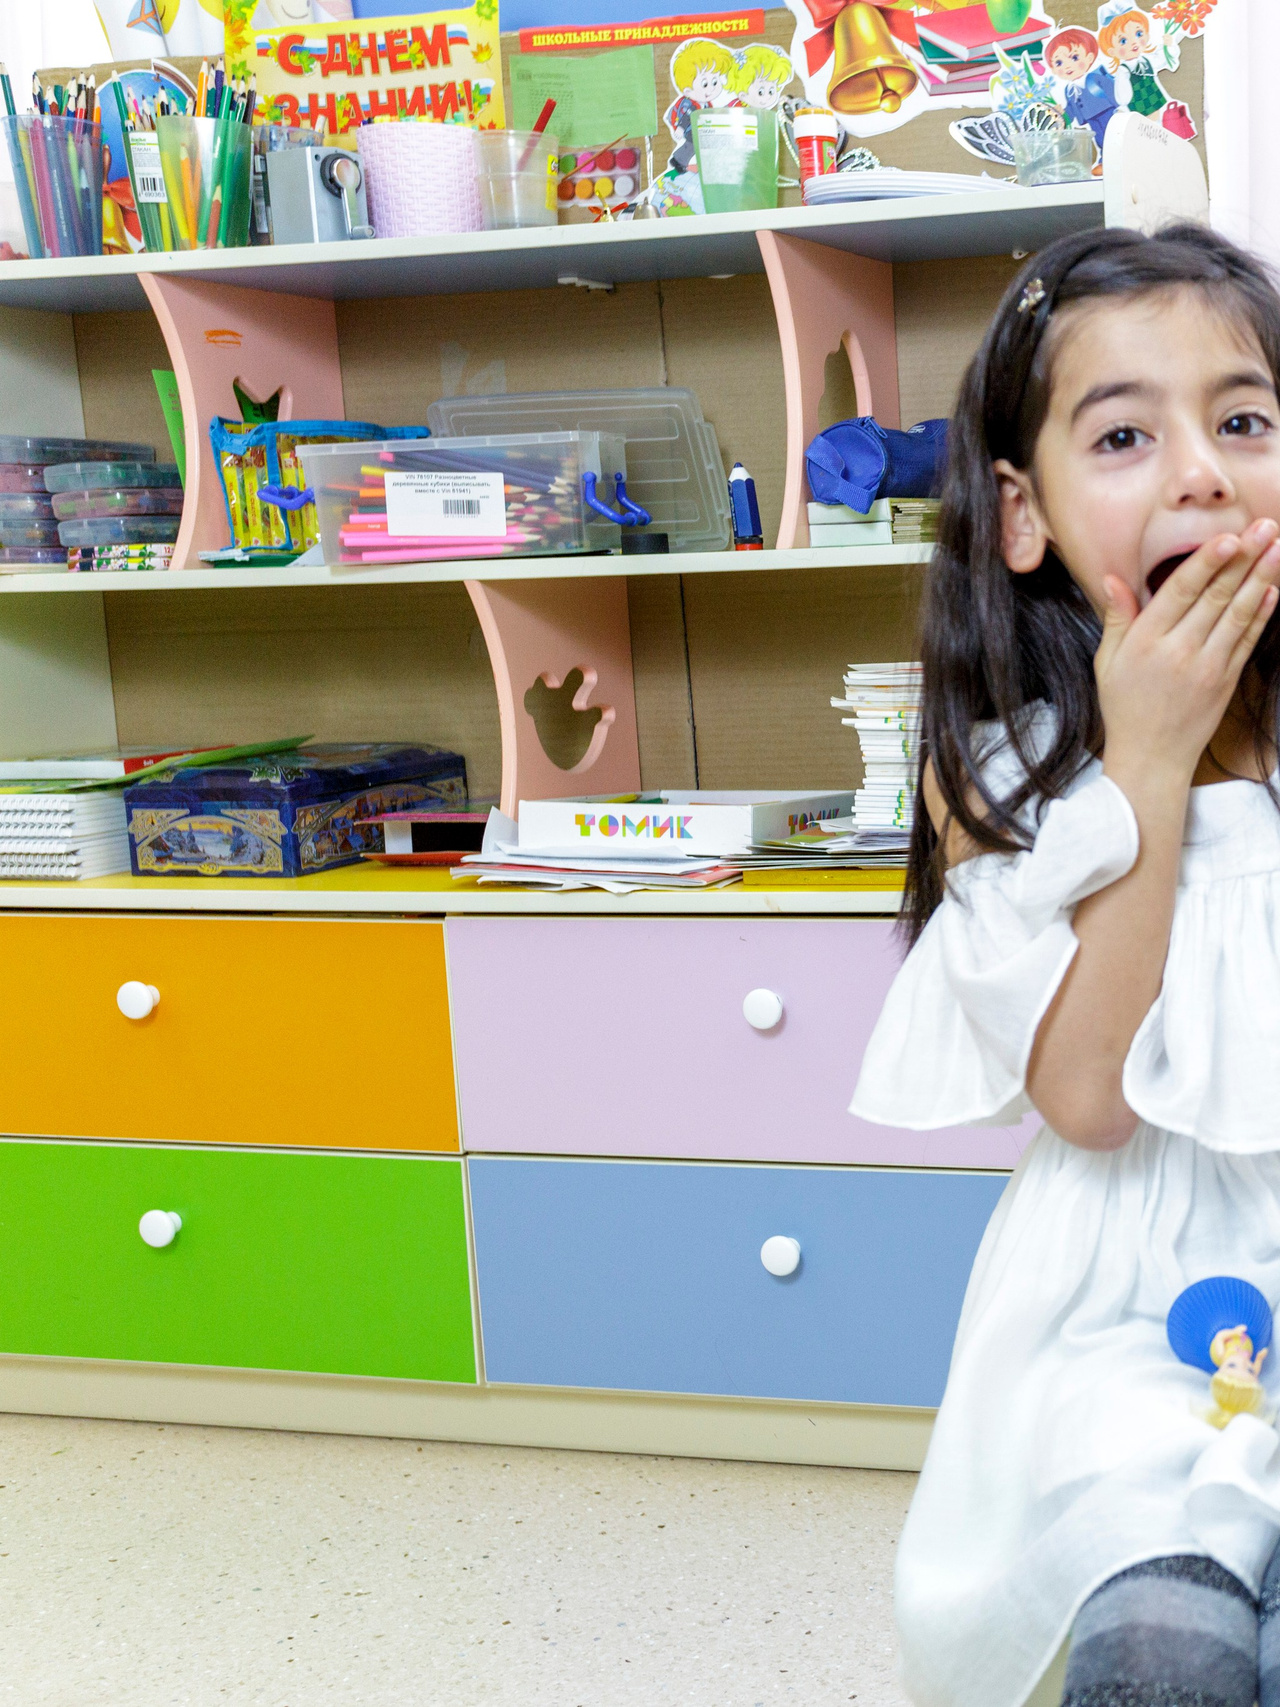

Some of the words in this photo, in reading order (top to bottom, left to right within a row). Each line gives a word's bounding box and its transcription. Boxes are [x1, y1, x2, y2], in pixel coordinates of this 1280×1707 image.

[532, 29, 612, 47] ШКОЛЬНЫЕ
[613, 18, 750, 41] ПРИНАДЛЕЖНОСТИ
[277, 34, 306, 76] С
[575, 814, 693, 839] ТОМИК
